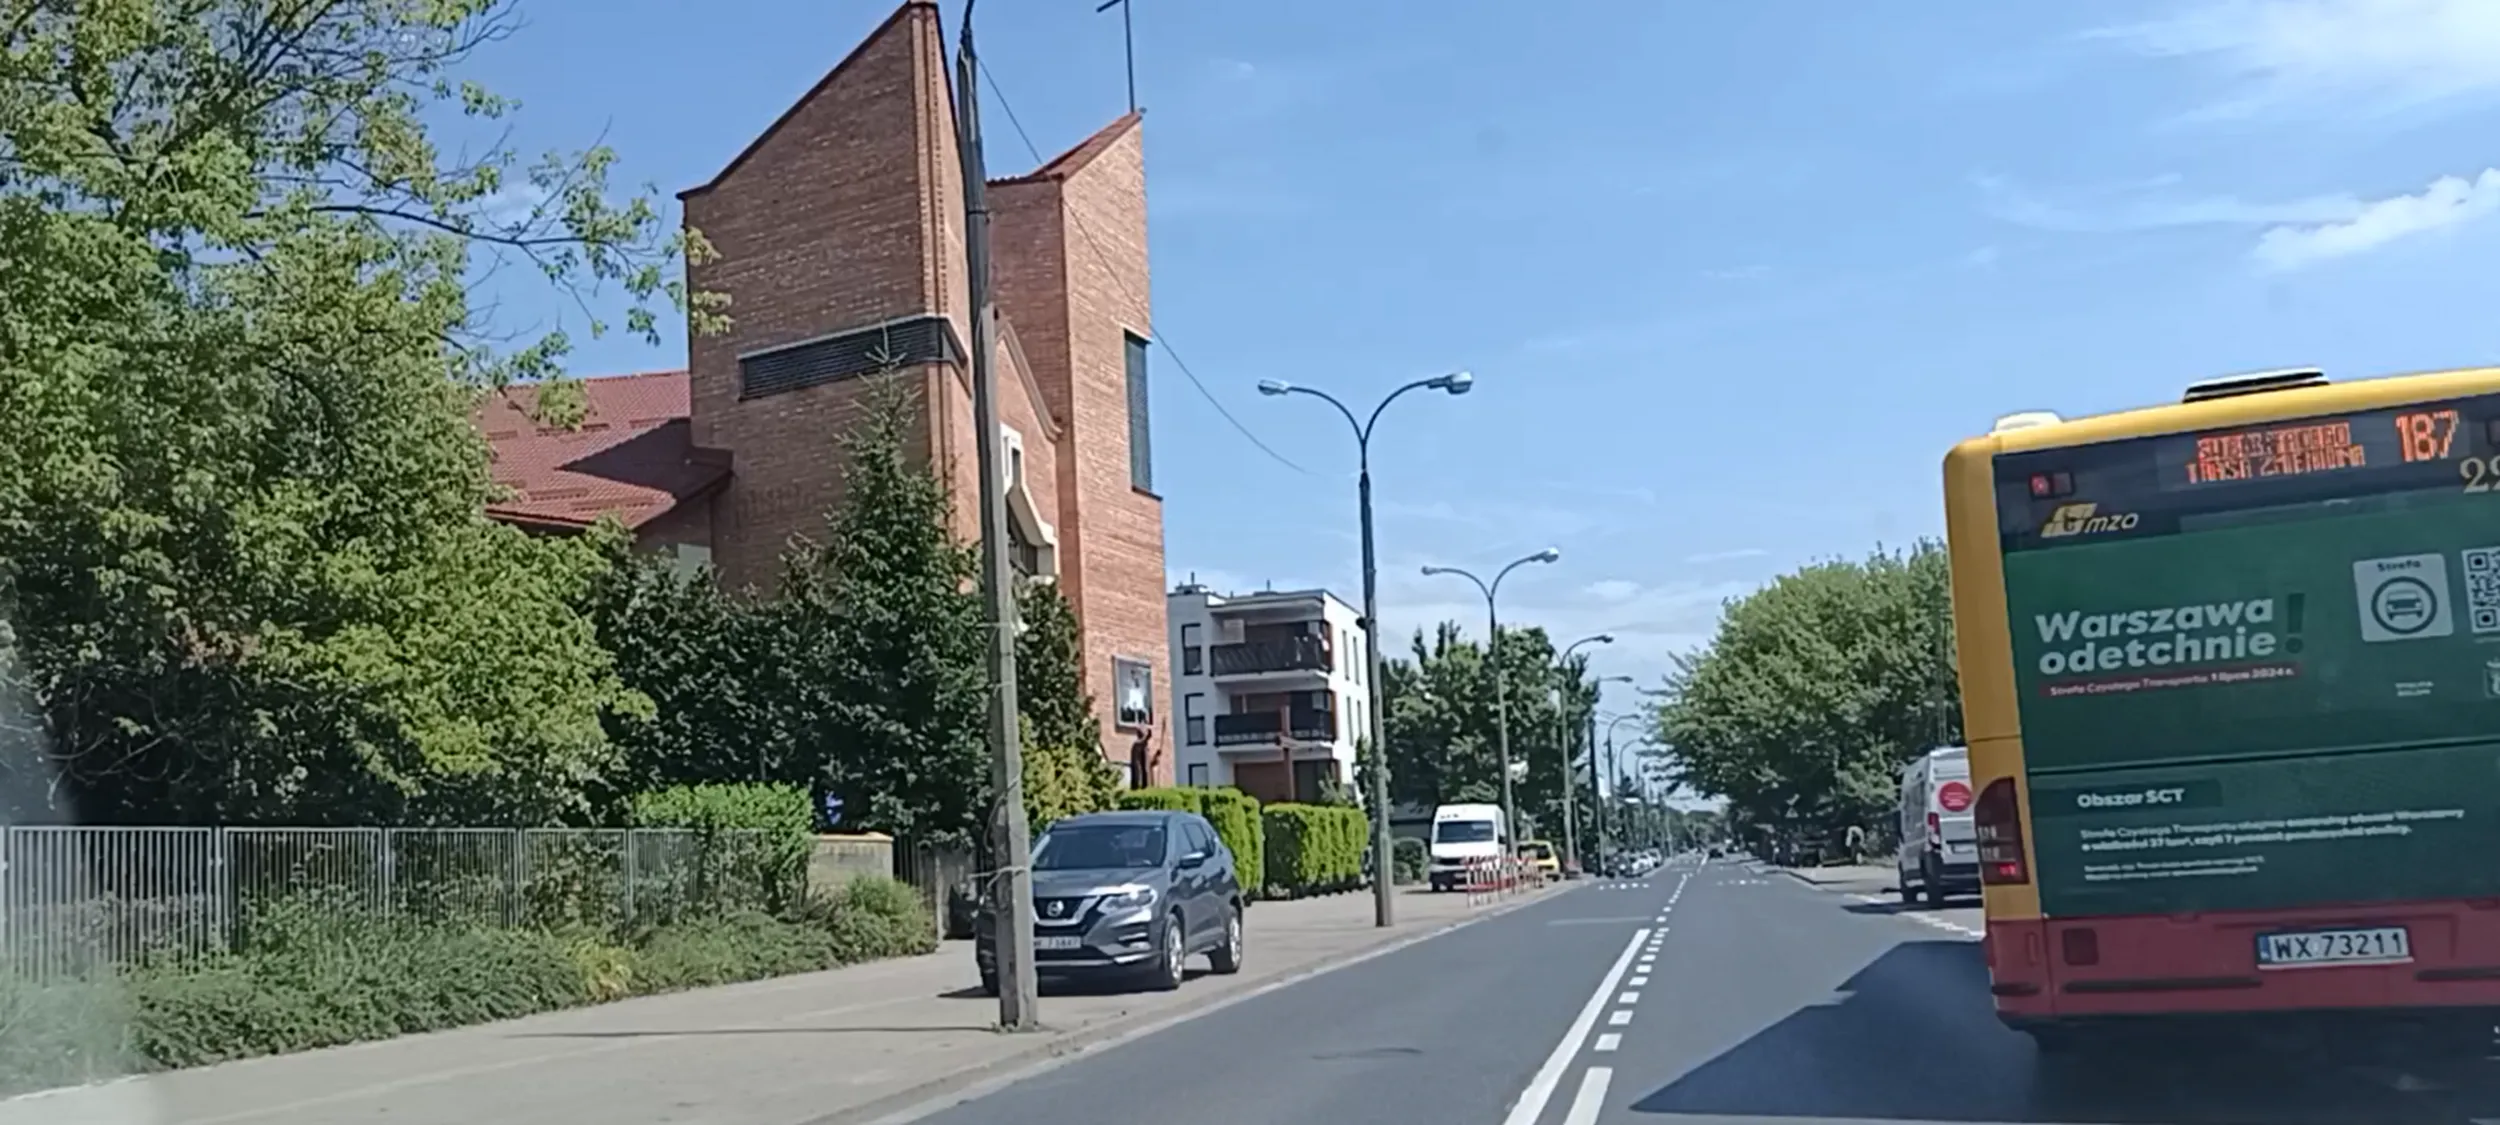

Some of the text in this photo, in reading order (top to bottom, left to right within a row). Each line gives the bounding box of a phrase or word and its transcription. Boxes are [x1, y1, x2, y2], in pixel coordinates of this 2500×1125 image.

[2395, 409, 2460, 463] 187
[2034, 598, 2275, 643] Warszawa
[2038, 626, 2276, 676] odetchnie
[2076, 788, 2186, 809] Obszar SCT
[2274, 932, 2403, 959] WX 73211
